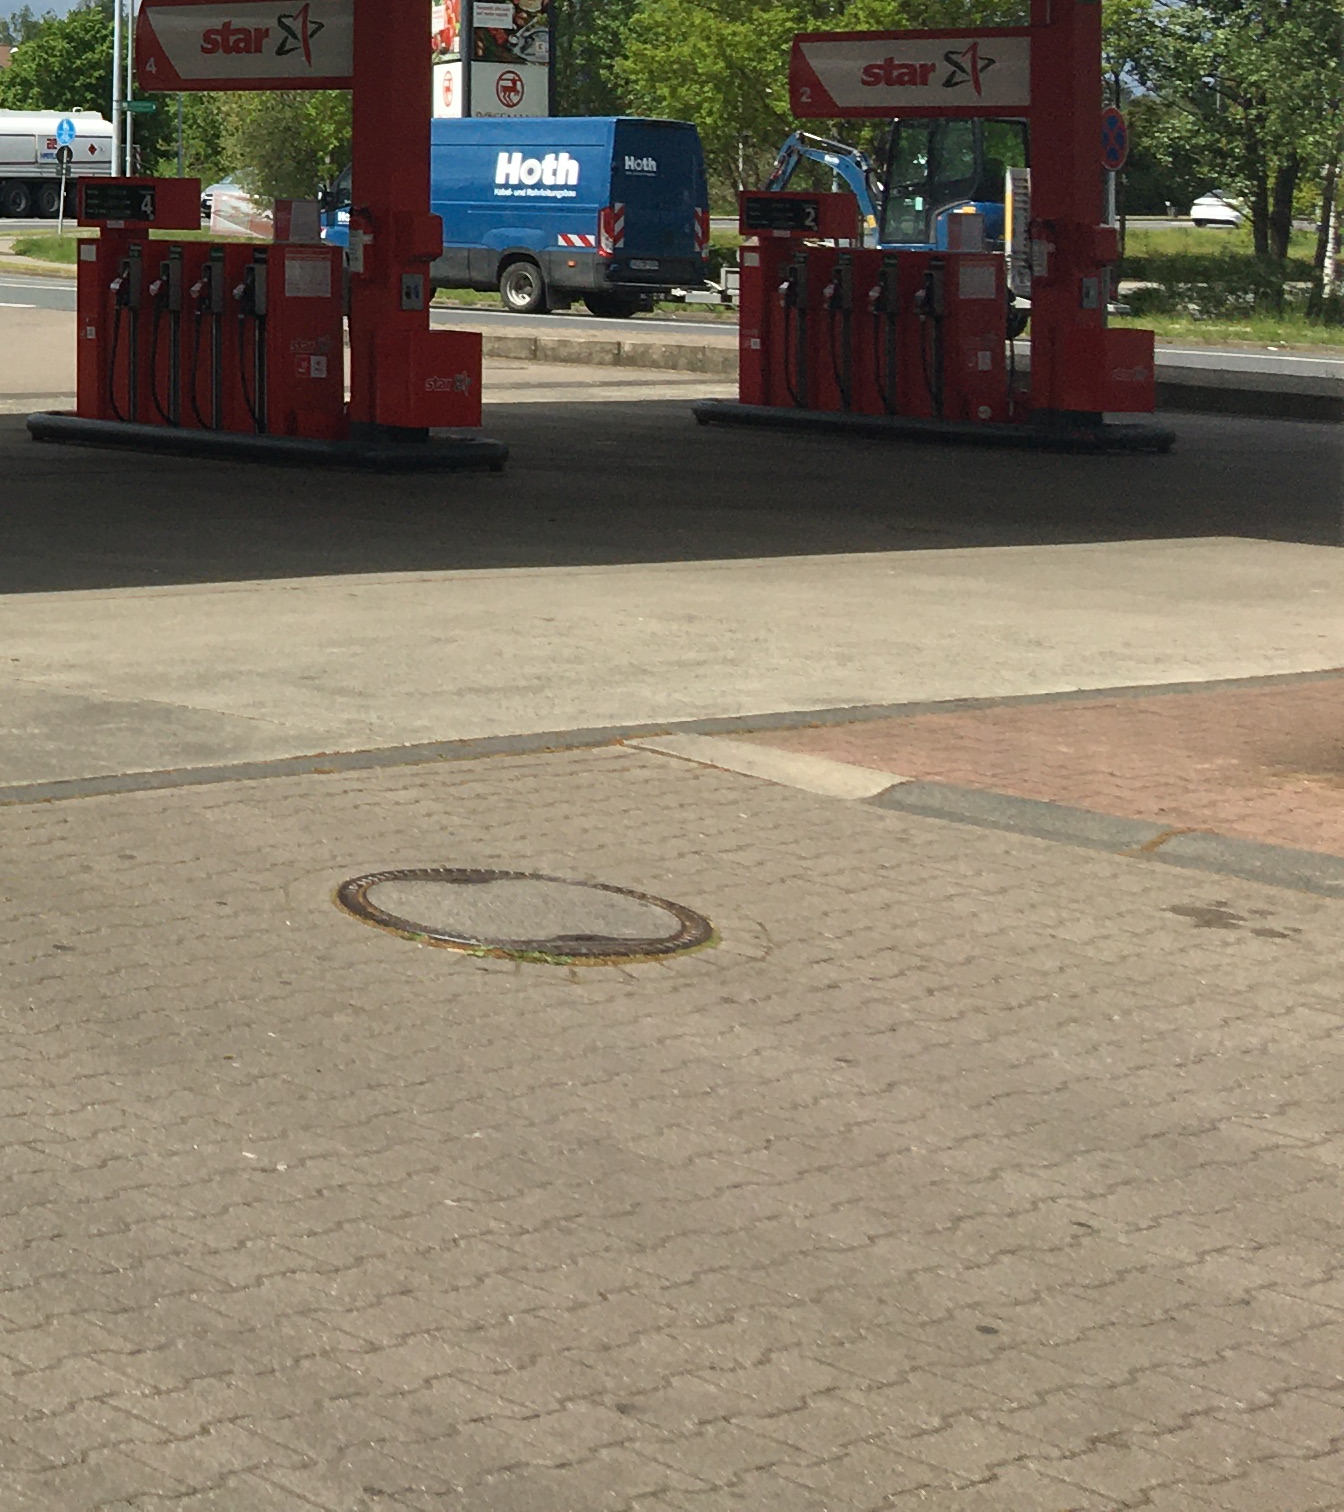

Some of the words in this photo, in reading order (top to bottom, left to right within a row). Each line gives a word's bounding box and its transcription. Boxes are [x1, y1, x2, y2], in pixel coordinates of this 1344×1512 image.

[200, 20, 270, 55] star
[145, 56, 157, 74] 4
[861, 56, 937, 87] star
[800, 87, 812, 103] 2
[494, 152, 580, 186] Hoth
[624, 155, 657, 172] Hoth
[140, 194, 153, 215] 4
[425, 375, 453, 392] star
